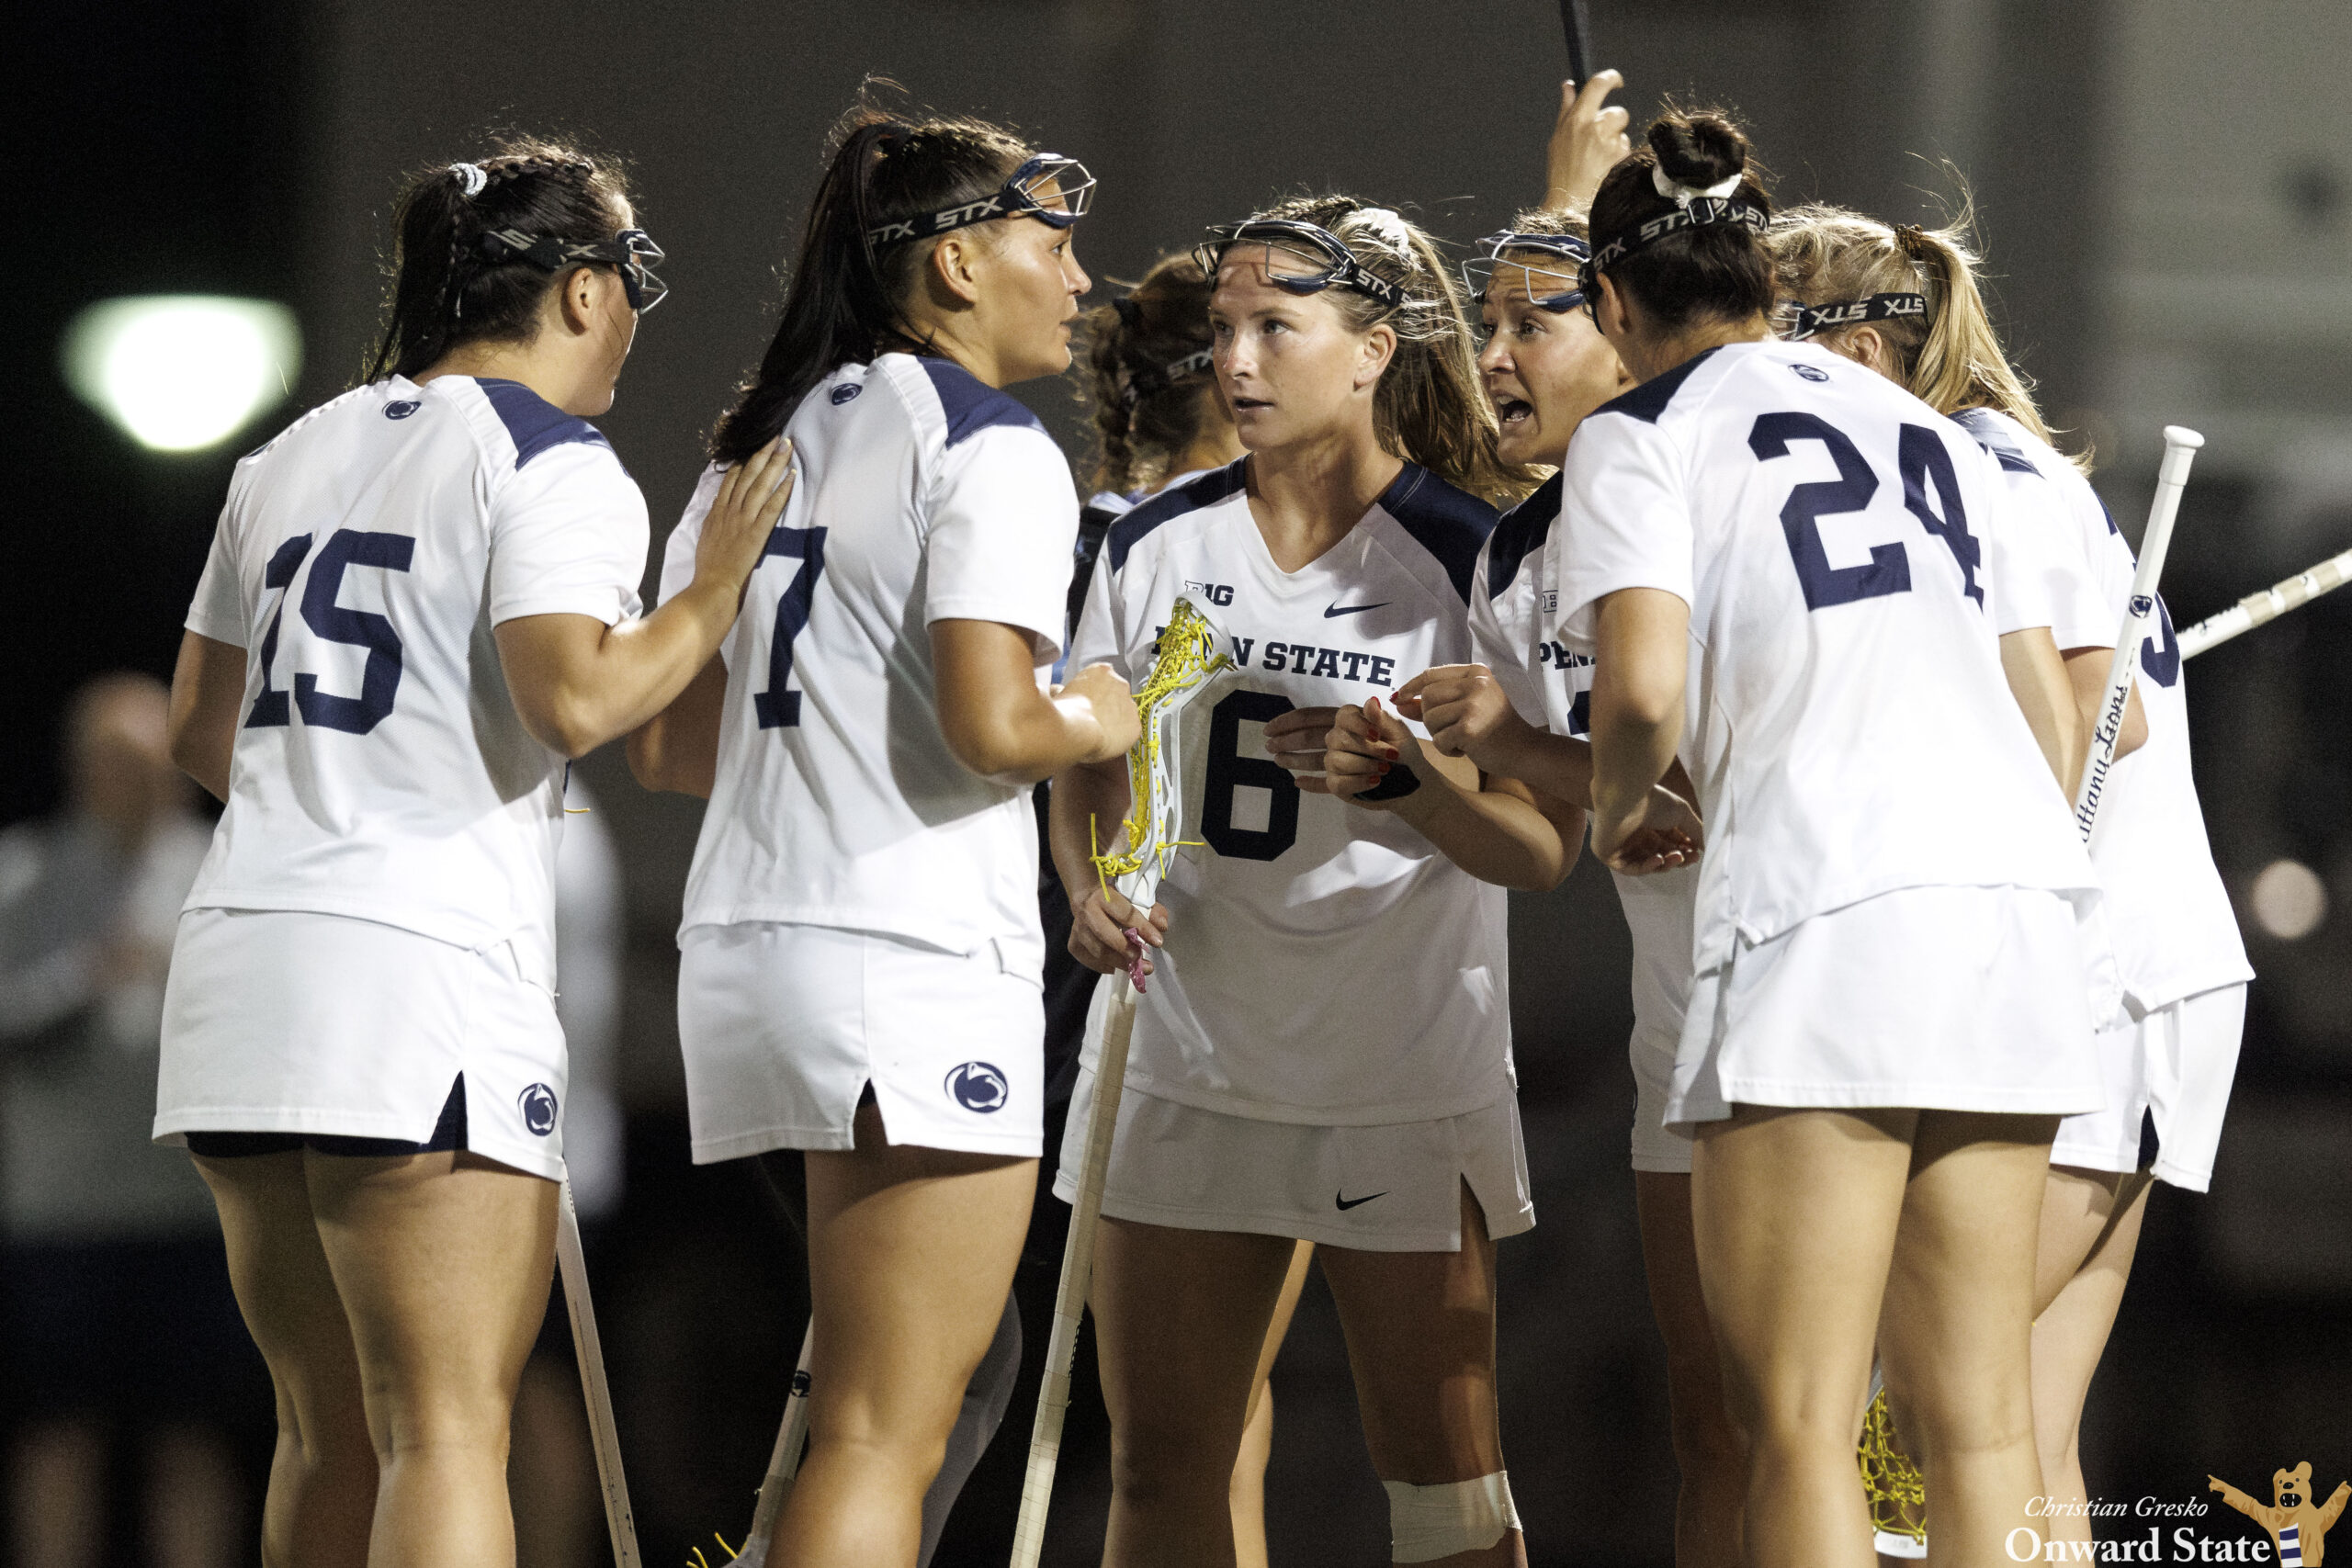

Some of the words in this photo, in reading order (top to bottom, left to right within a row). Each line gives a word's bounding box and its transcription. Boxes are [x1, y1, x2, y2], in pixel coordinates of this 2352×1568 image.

[934, 196, 1004, 231] STX
[1592, 237, 1627, 274] STX
[1355, 266, 1394, 301] STX
[1809, 302, 1869, 326] STX
[1883, 297, 1925, 317] STX
[1747, 411, 1985, 614] 24
[243, 527, 417, 736] 15
[754, 525, 829, 730] 7
[1261, 640, 1396, 688] STATE
[1200, 689, 1301, 863] 6
